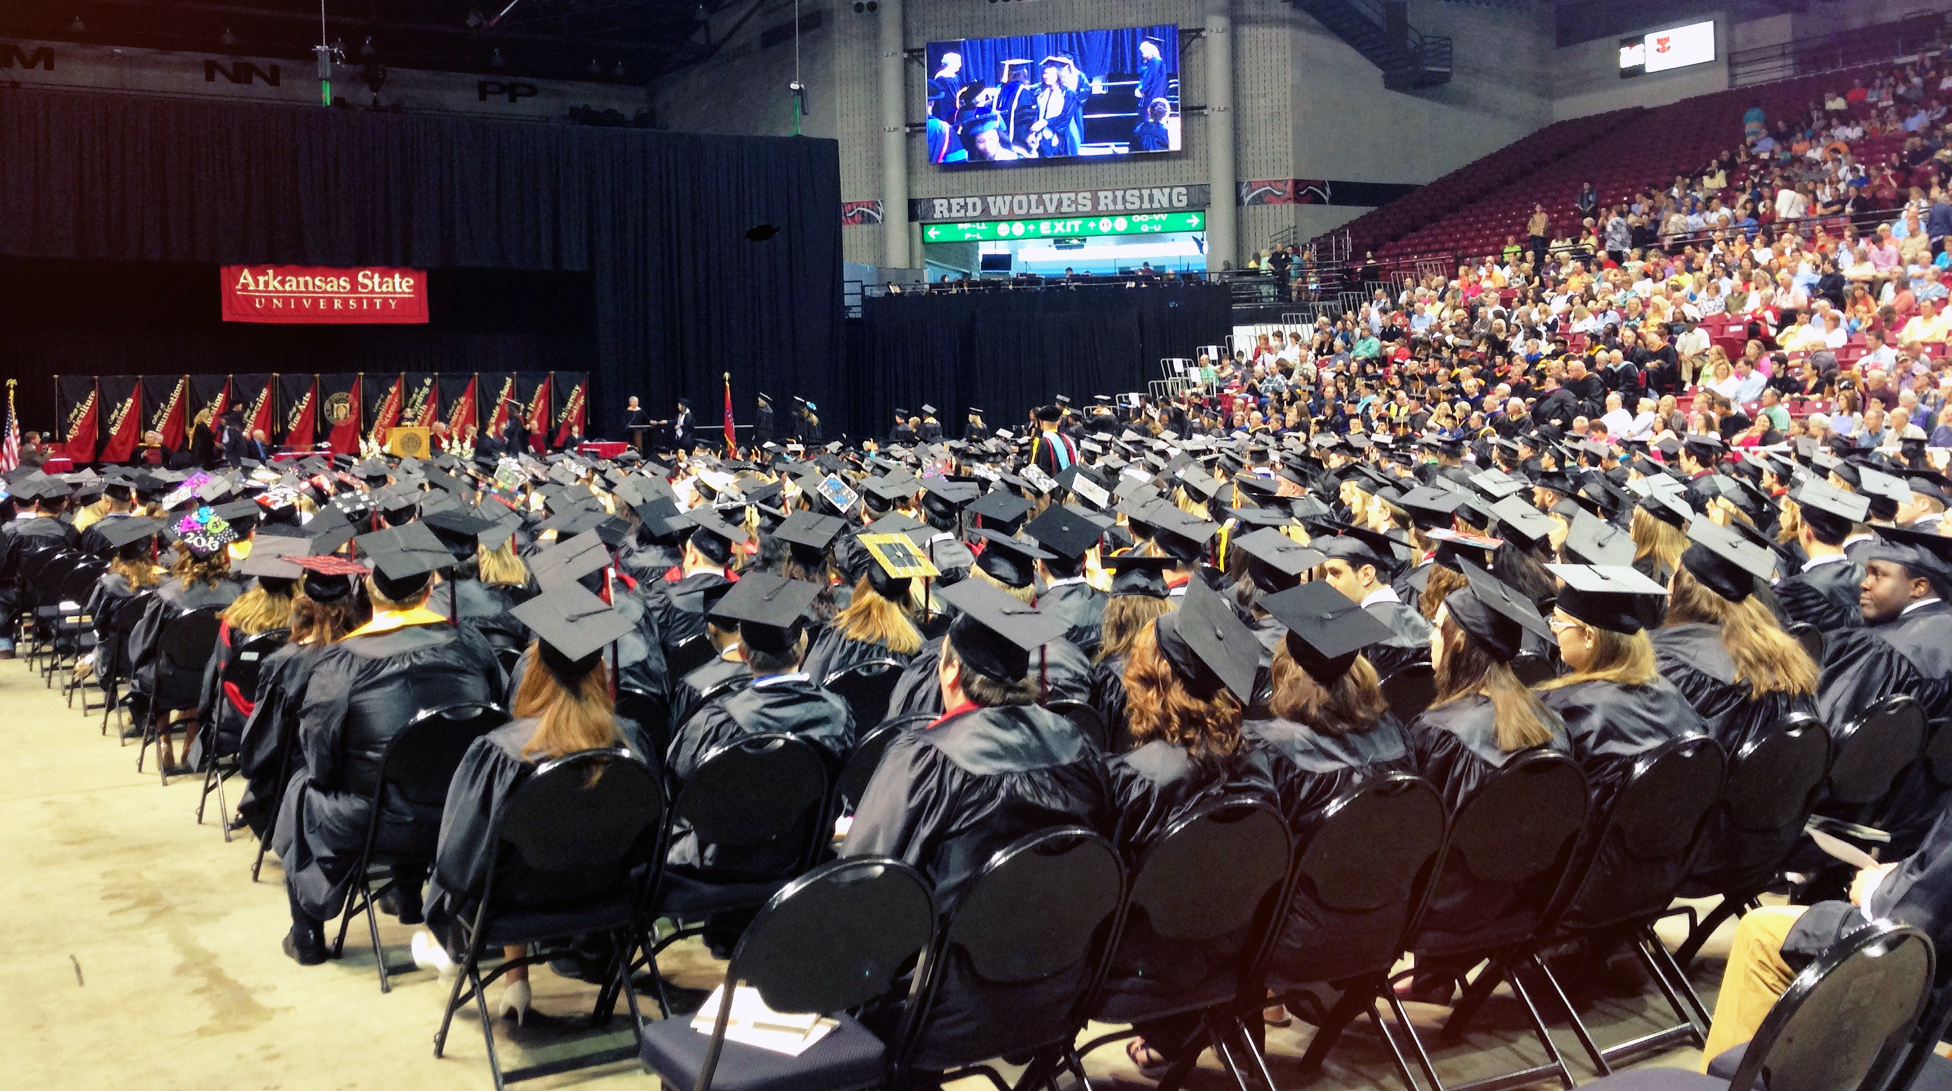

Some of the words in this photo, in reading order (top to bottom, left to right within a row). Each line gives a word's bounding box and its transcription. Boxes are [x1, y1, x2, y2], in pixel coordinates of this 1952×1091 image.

[204, 59, 281, 87] NN
[478, 80, 538, 103] PP
[933, 197, 982, 219] RED
[987, 191, 1093, 216] WOLVES
[1097, 186, 1188, 211] RISING
[1040, 220, 1083, 234] EXIT
[235, 268, 350, 291] Arkansas
[357, 270, 415, 293] State
[255, 298, 398, 309] UNIVERSITY
[496, 376, 512, 405] School
[527, 383, 544, 411] Honors
[557, 384, 582, 423] University
[66, 390, 95, 443] Agriculture
[109, 397, 134, 436] Business
[287, 412, 301, 432] Fine
[298, 391, 312, 415] Arts
